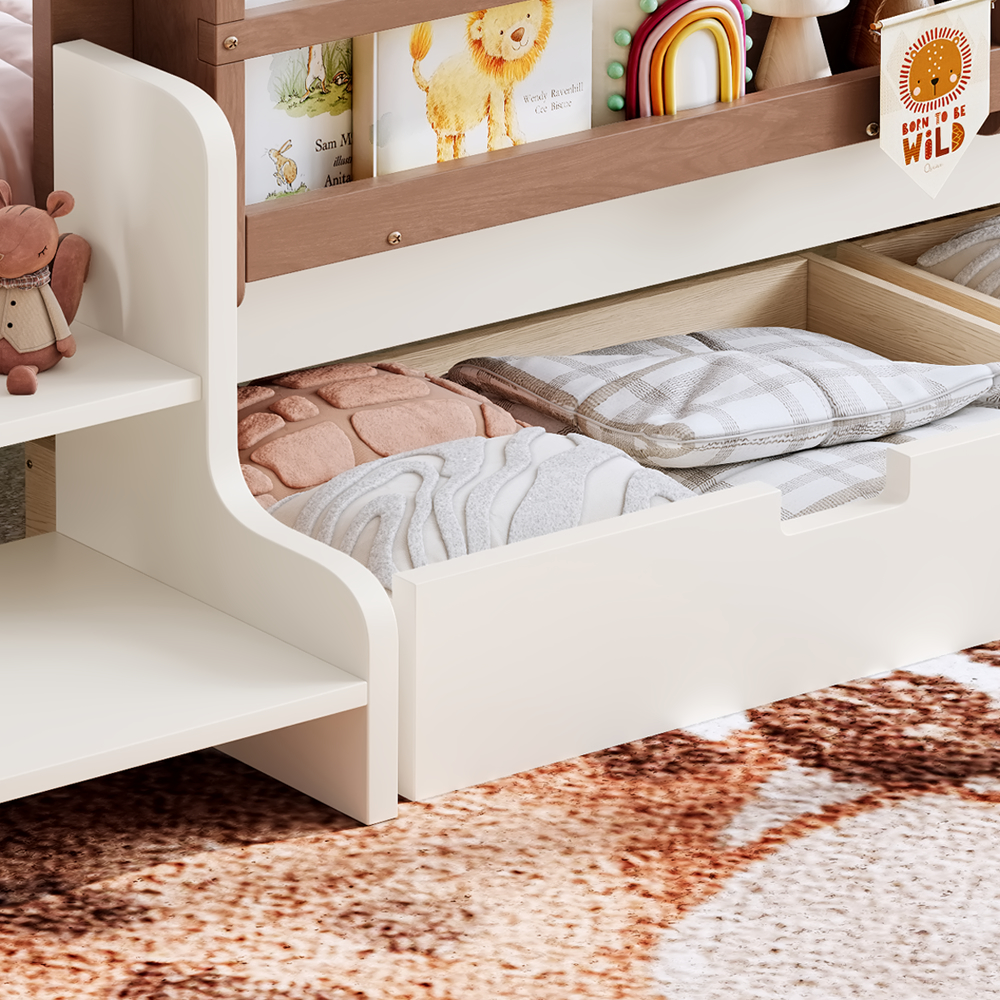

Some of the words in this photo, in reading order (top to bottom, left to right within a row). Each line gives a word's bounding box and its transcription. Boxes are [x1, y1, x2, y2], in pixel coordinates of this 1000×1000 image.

[902, 116, 929, 136] BORN
[935, 110, 948, 125] TO
[953, 104, 966, 120] BE
[315, 138, 337, 152] Sam
[324, 171, 352, 188] Anita
